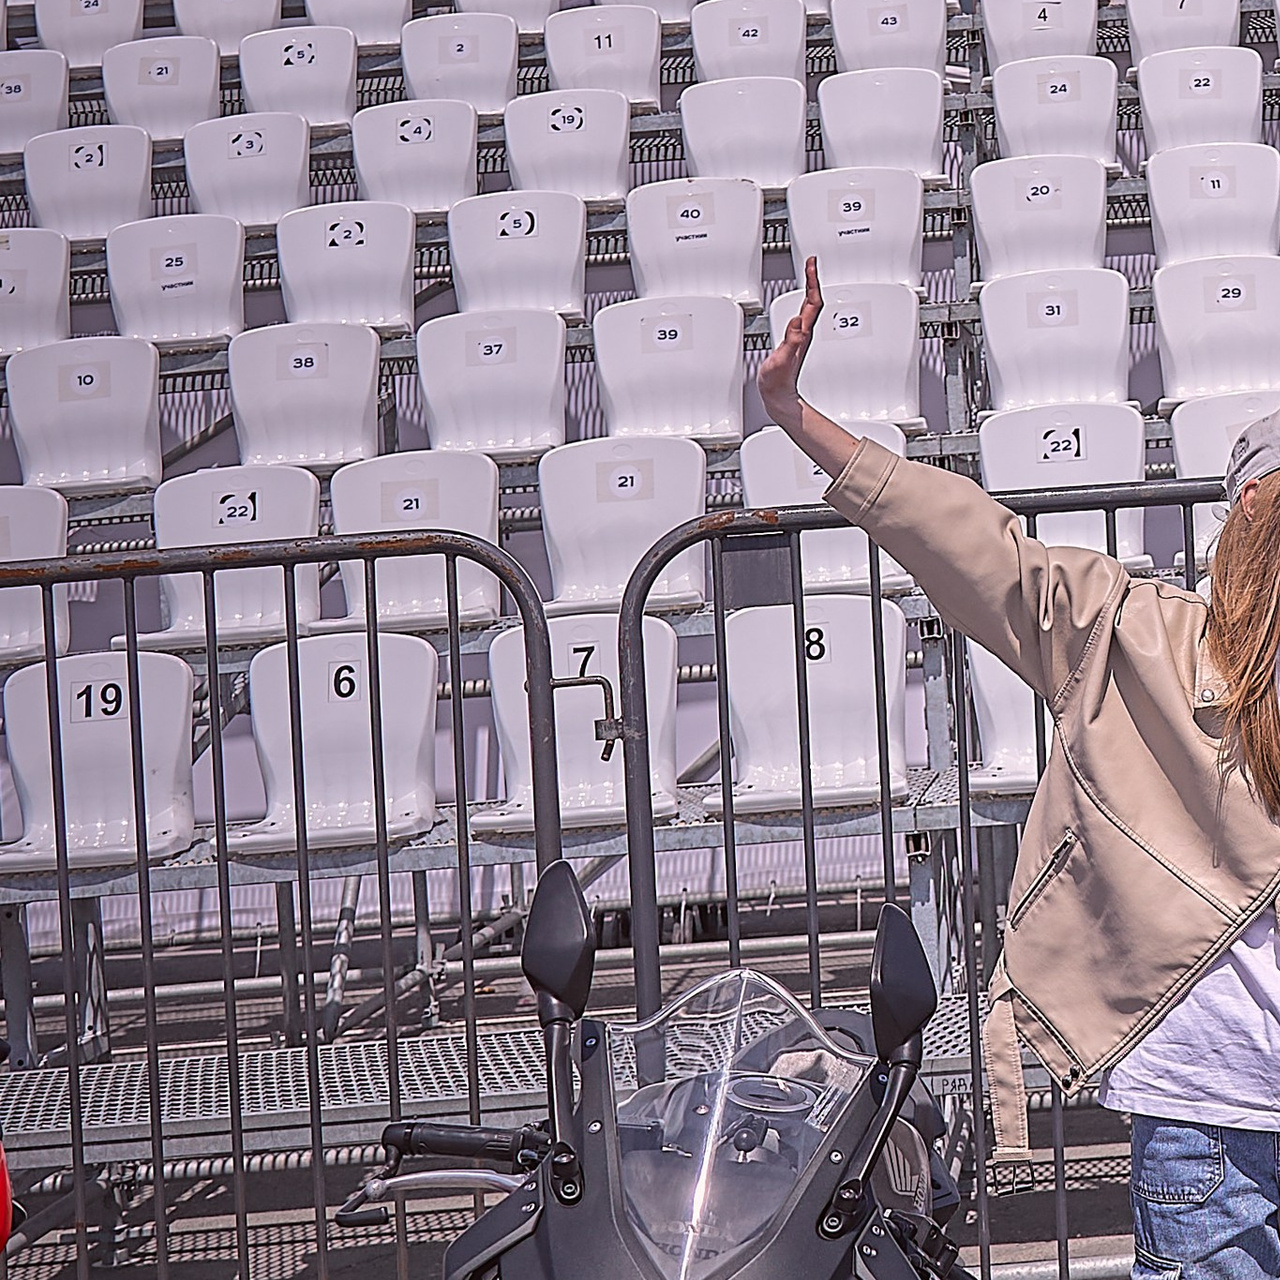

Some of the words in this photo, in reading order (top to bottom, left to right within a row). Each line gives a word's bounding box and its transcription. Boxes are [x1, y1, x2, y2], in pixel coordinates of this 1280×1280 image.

[84, 0, 99, 9] 24
[1037, 7, 1048, 22] 4
[880, 16, 898, 26] 43
[742, 28, 759, 38] 42
[594, 33, 612, 50] 11
[156, 66, 169, 76] 21
[1050, 83, 1067, 94] 24
[1193, 77, 1211, 88] 22
[5, 84, 22, 95] 38
[561, 114, 575, 125] 19
[1210, 179, 1221, 189] 11
[1030, 185, 1050, 197] 20
[842, 201, 862, 213] 39
[680, 209, 701, 219] 40
[165, 256, 184, 268] 25
[1221, 287, 1242, 299] 29
[1045, 305, 1061, 316] 31
[839, 316, 859, 329] 32
[657, 329, 678, 341] 39
[483, 343, 503, 356] 37
[293, 357, 314, 369] 38
[77, 374, 94, 386] 10
[1050, 439, 1072, 453] 22
[617, 475, 634, 488] 21
[402, 497, 420, 511] 21
[226, 505, 249, 518] 22
[804, 627, 826, 661] 8
[572, 646, 596, 678] 7
[333, 664, 356, 699] 6
[76, 682, 123, 718] 19
